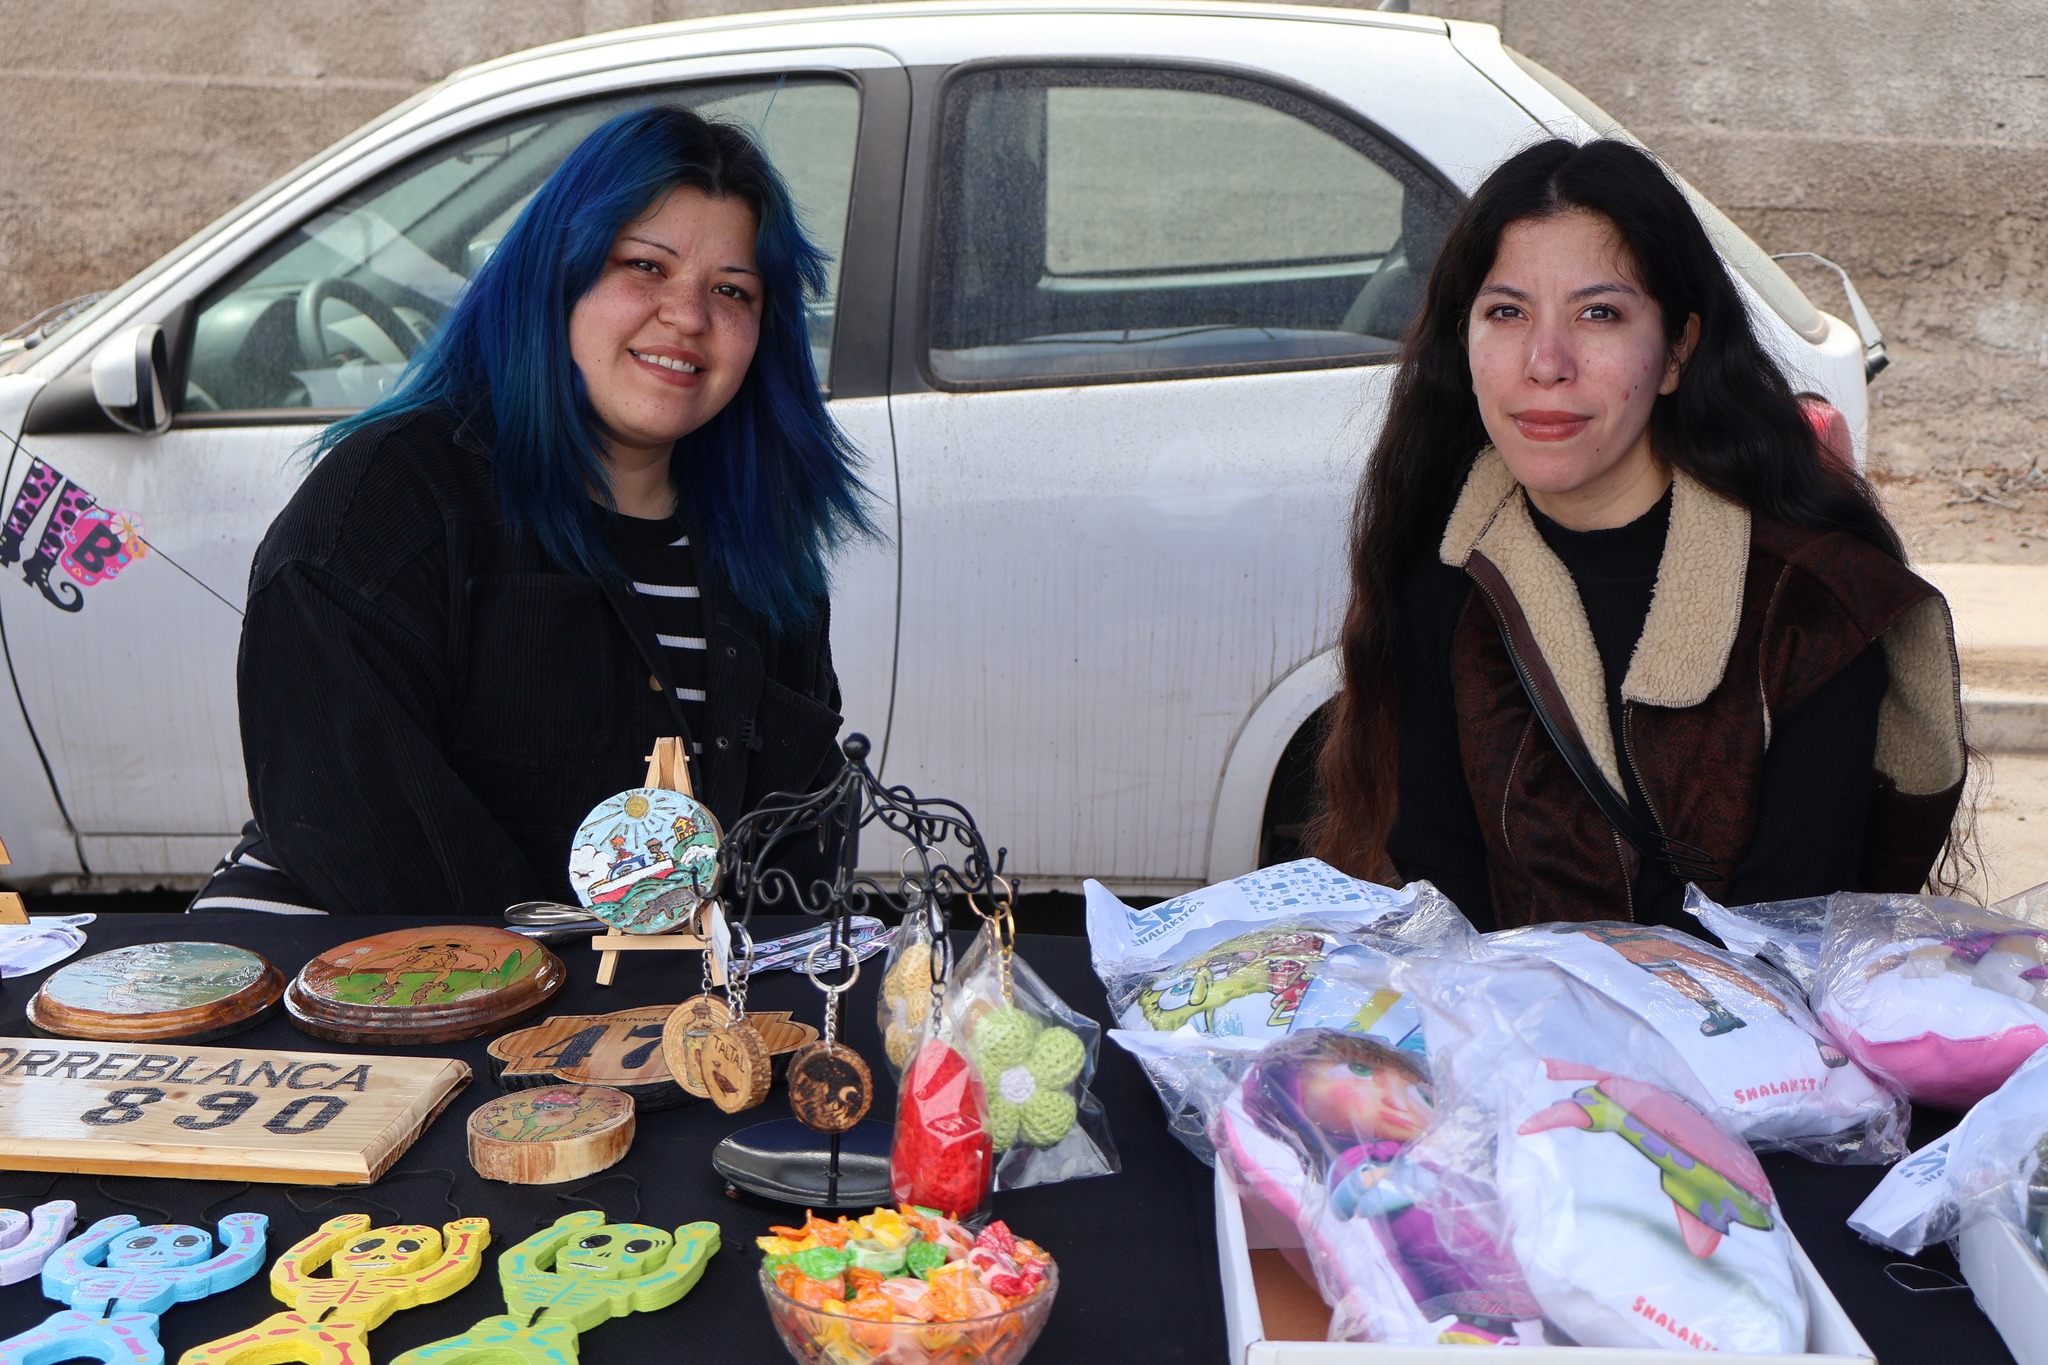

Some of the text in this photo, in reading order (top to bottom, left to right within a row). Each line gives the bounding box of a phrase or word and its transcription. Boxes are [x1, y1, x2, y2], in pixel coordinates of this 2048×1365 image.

[71, 522, 122, 573] B
[1131, 901, 1205, 946] SHALAKITOS
[714, 1035, 745, 1073] TALTAL
[1734, 1078, 1828, 1104] SHALAKIT
[1632, 1296, 1719, 1351] SHALAKI
